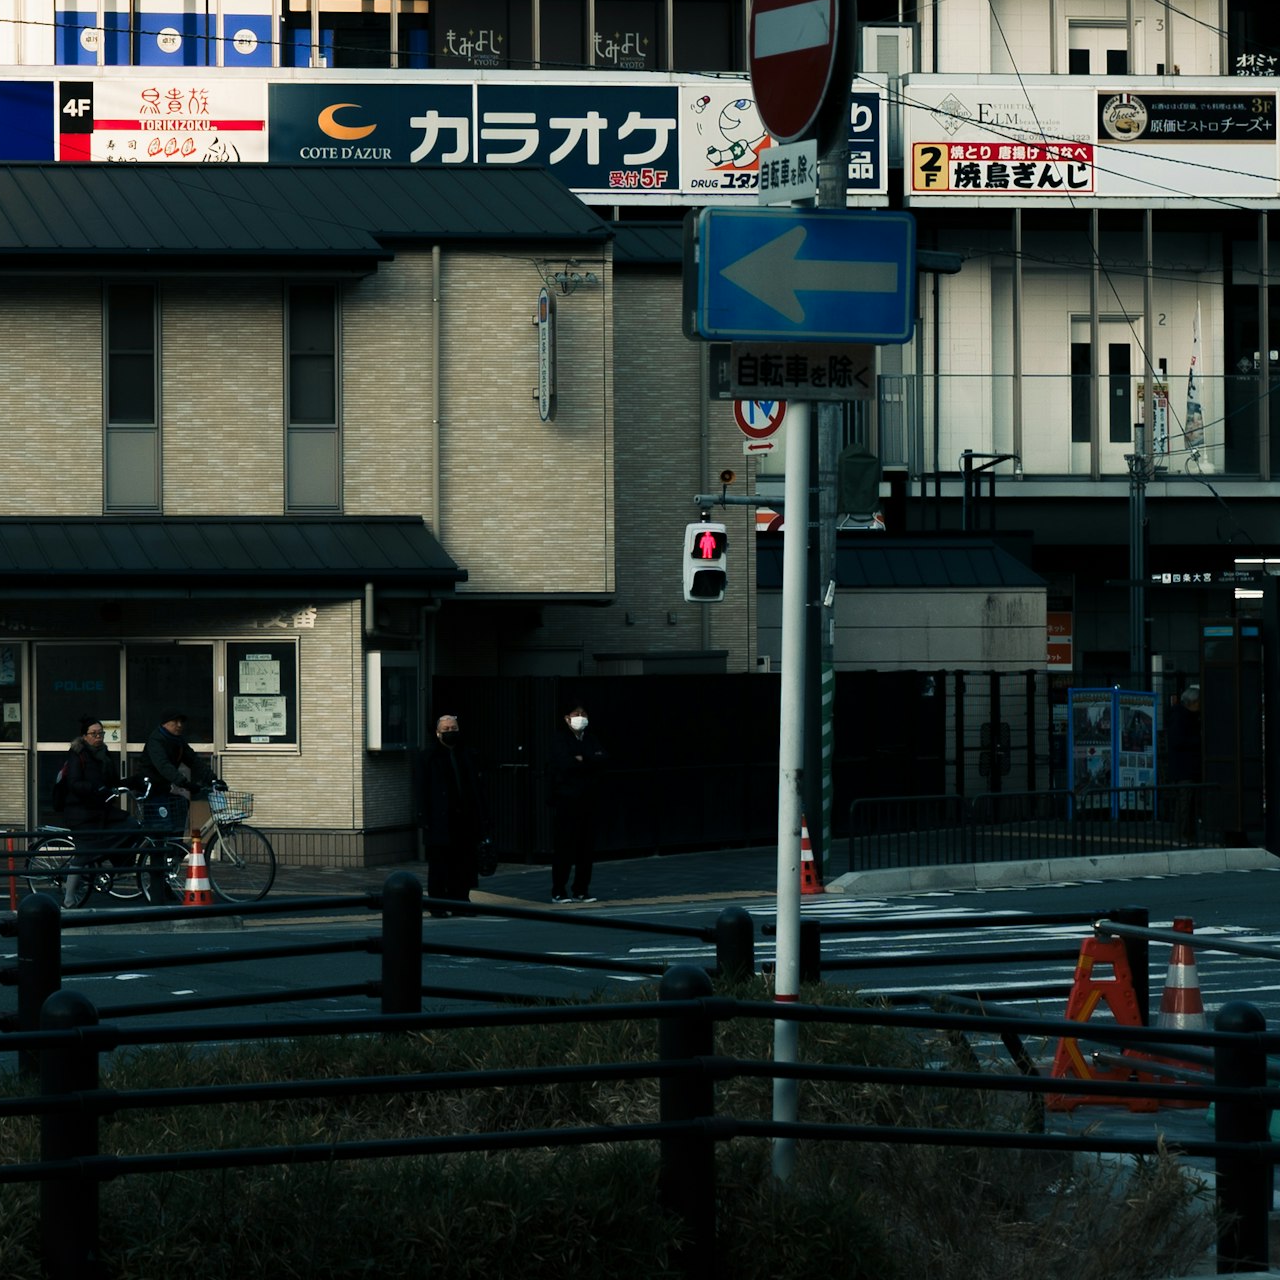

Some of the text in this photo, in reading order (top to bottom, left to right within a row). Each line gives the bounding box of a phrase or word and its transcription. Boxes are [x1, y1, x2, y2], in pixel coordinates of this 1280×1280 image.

[474, 58, 500, 67] KYOTO
[620, 61, 645, 69] KYOTO
[63, 99, 91, 117] 4F
[139, 87, 210, 116] 鳥貴族
[1251, 97, 1274, 114] 3F
[138, 120, 211, 132] TORIKIZOKU
[409, 109, 677, 166] カラオケ
[299, 146, 339, 160] COTE
[950, 145, 991, 160] 焼とり
[998, 145, 1039, 160] 唐揚げ
[609, 169, 668, 188] 受付 5F
[761, 155, 814, 191] 自転車を除く
[954, 161, 1089, 189] 焼鳥ぎんじ
[691, 179, 719, 189] DRUG
[736, 354, 870, 389] 自転車を除く
[52, 678, 104, 694] POLICE
